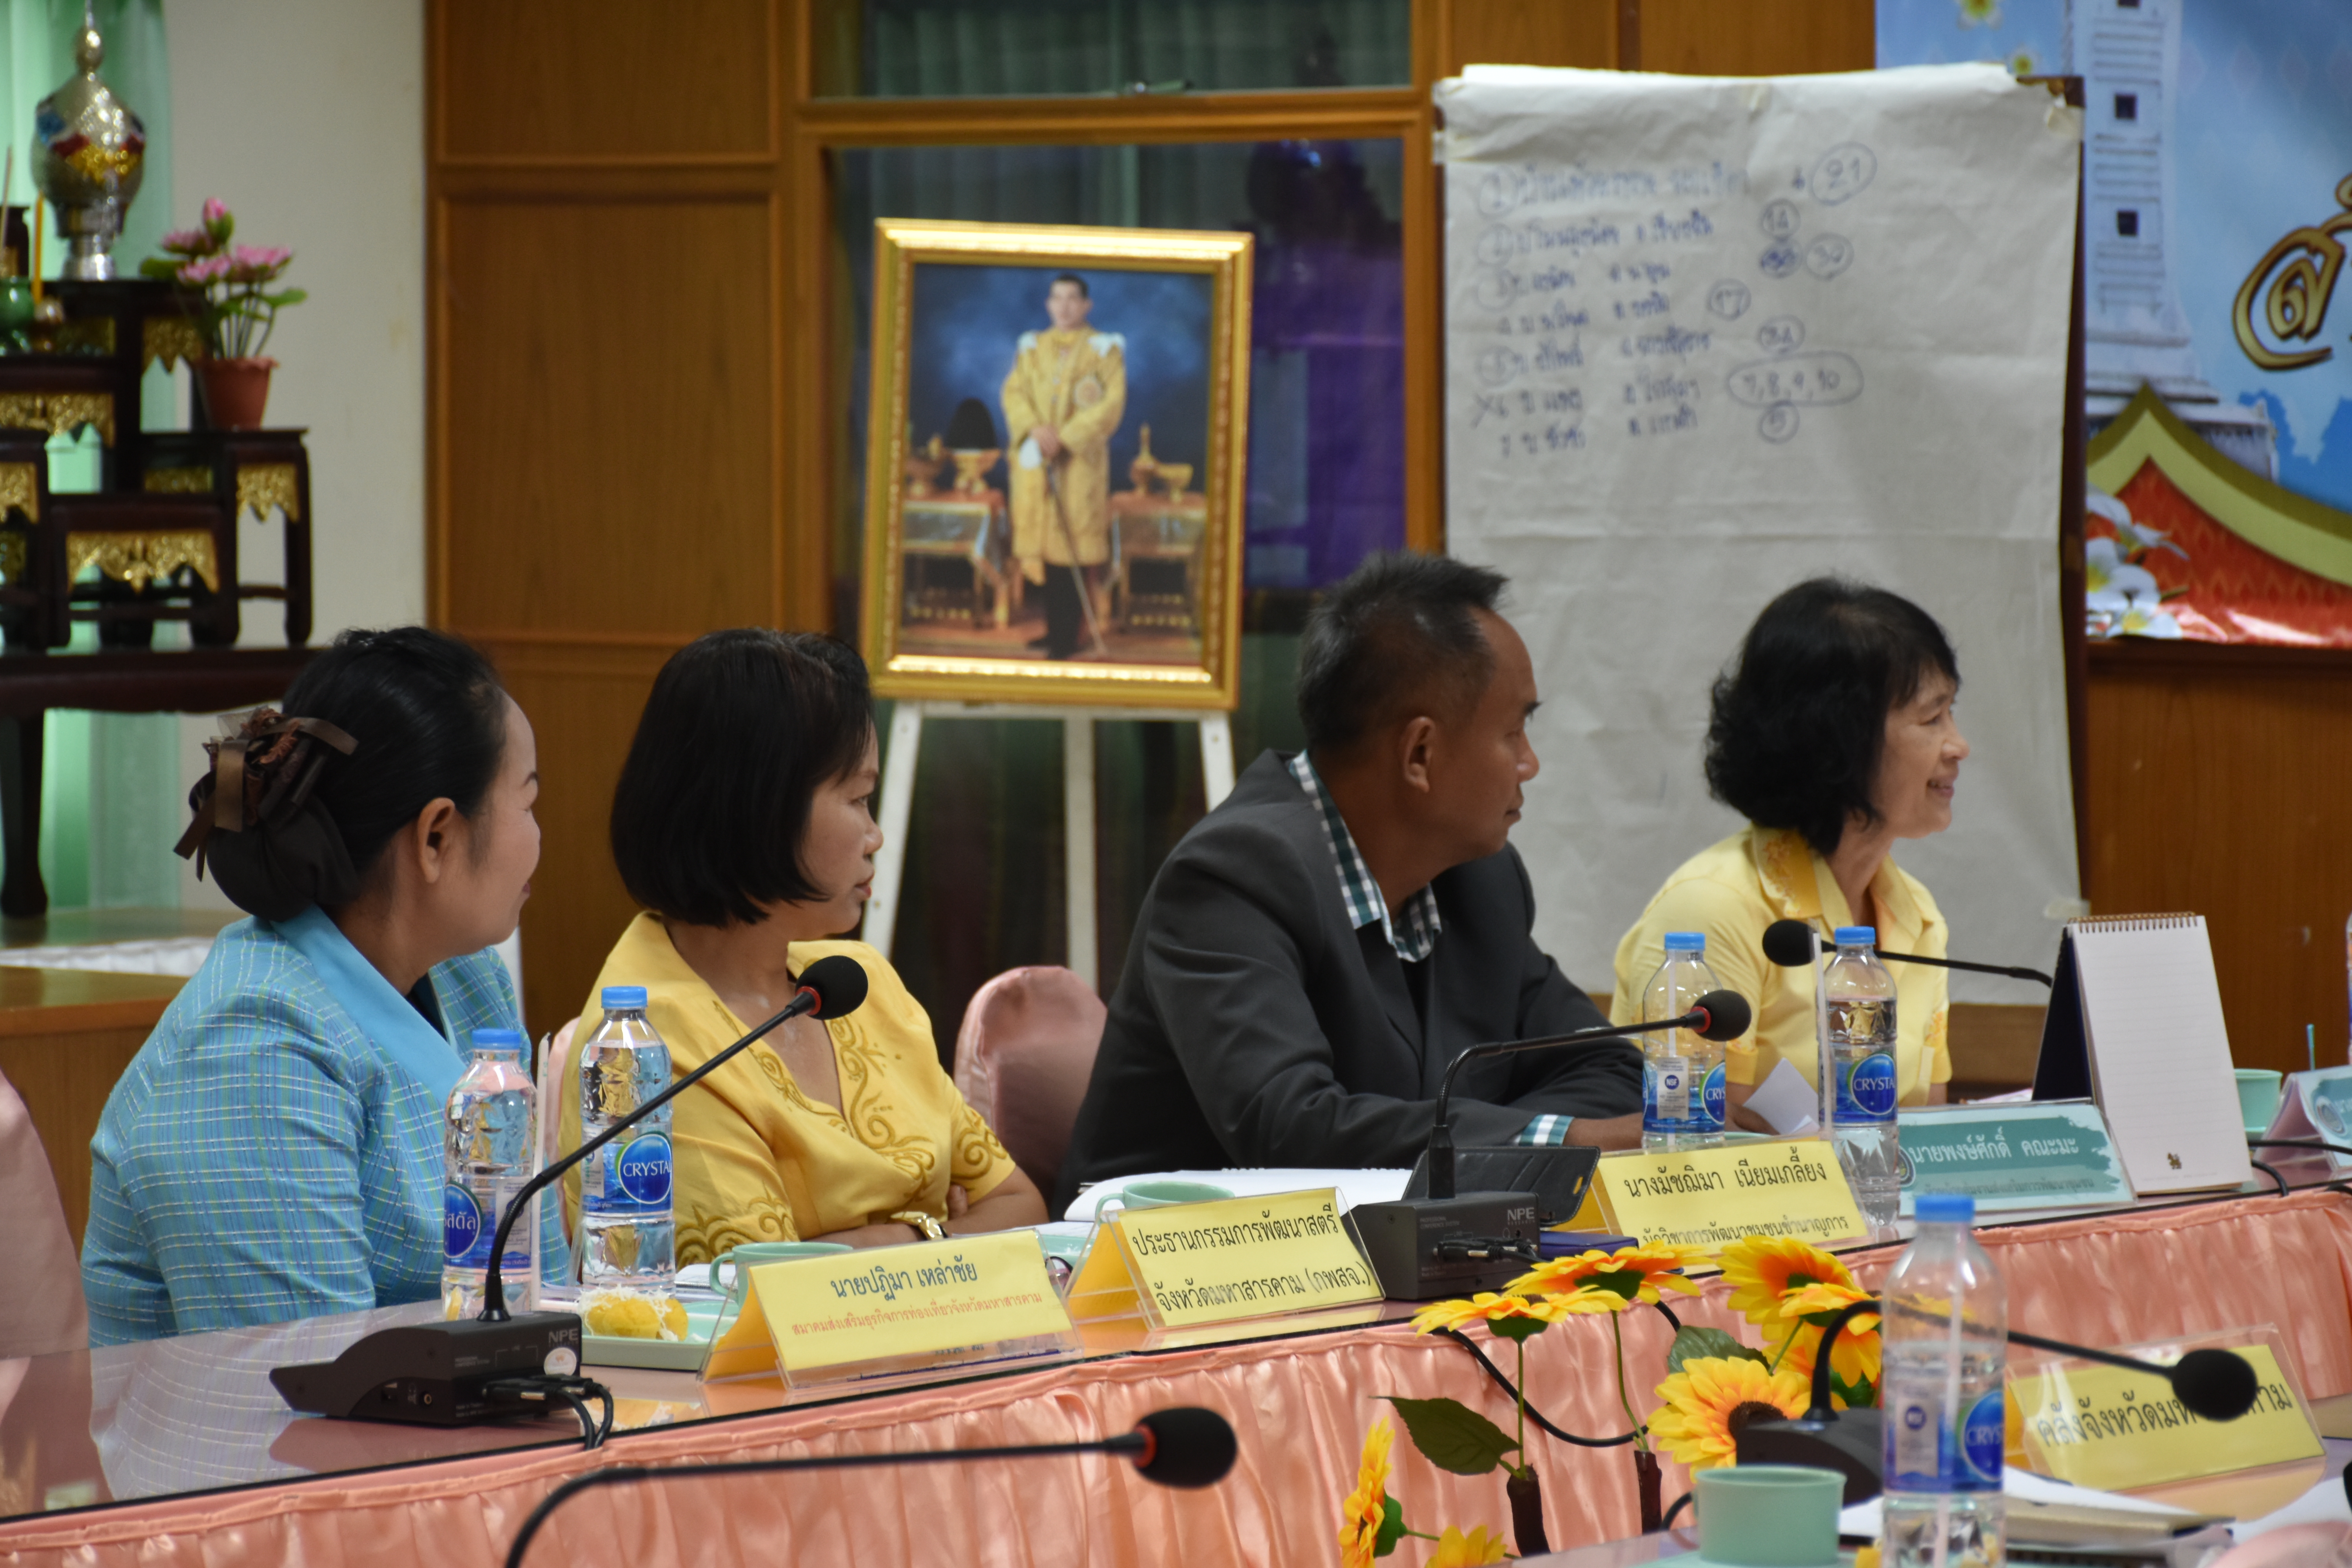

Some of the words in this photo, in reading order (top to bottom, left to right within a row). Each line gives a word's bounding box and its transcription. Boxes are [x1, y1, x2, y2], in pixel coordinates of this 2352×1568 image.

[1706, 1087, 1726, 1101] CRYS
[1853, 1077, 1895, 1091] CRYSTA
[2021, 1138, 2079, 1156] คณะมะ
[1624, 1165, 1724, 1198] นางมัชฌิมา
[1734, 1146, 1828, 1188] เนียมเกลี้ยง
[1132, 1202, 1339, 1256] ประธานกรรมการพัฒนาสตรี
[1506, 1207, 1535, 1221] NPE
[830, 1265, 913, 1301] นายปฏิมา
[916, 1254, 978, 1287] เหล่าชัย
[1154, 1274, 1306, 1312] จังหวัดมหาสารคาม
[1305, 1261, 1372, 1294] (กพสจ.)
[549, 1328, 579, 1343] NPE
[2037, 1383, 2293, 1448] คลังจังหวัดมหาม
